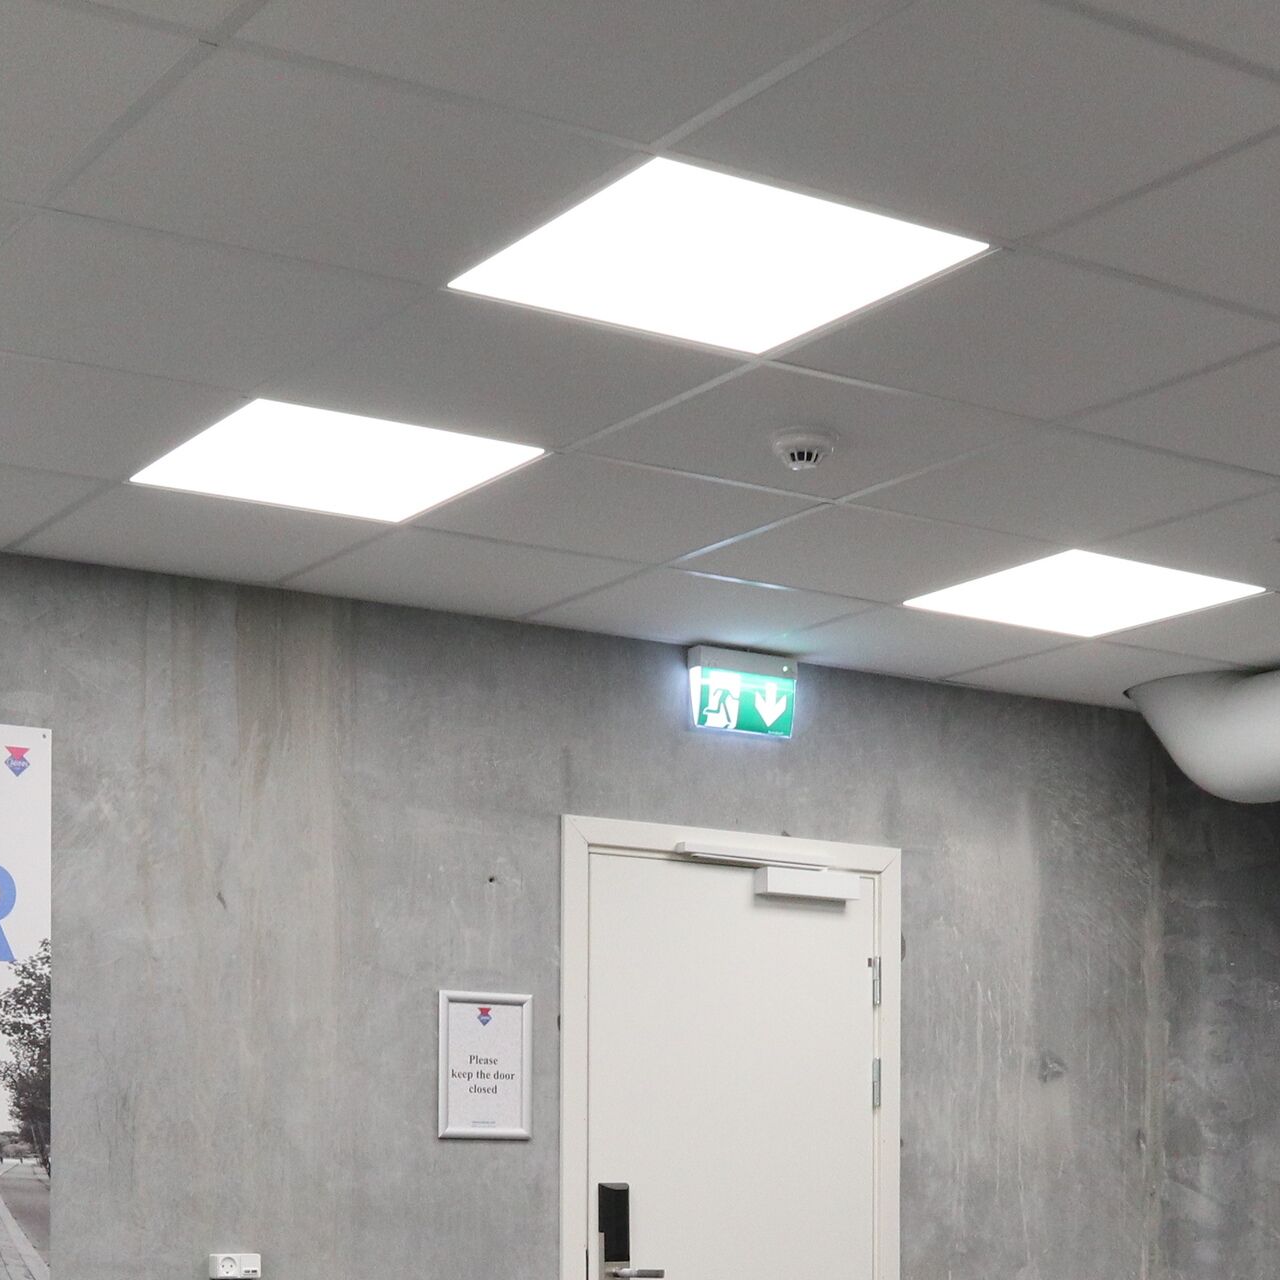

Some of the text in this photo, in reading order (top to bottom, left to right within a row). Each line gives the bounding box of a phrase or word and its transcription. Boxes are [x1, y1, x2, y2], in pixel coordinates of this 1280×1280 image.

[468, 1055, 499, 1066] Please
[451, 1069, 515, 1081] keep the door
[468, 1084, 498, 1094] closed
